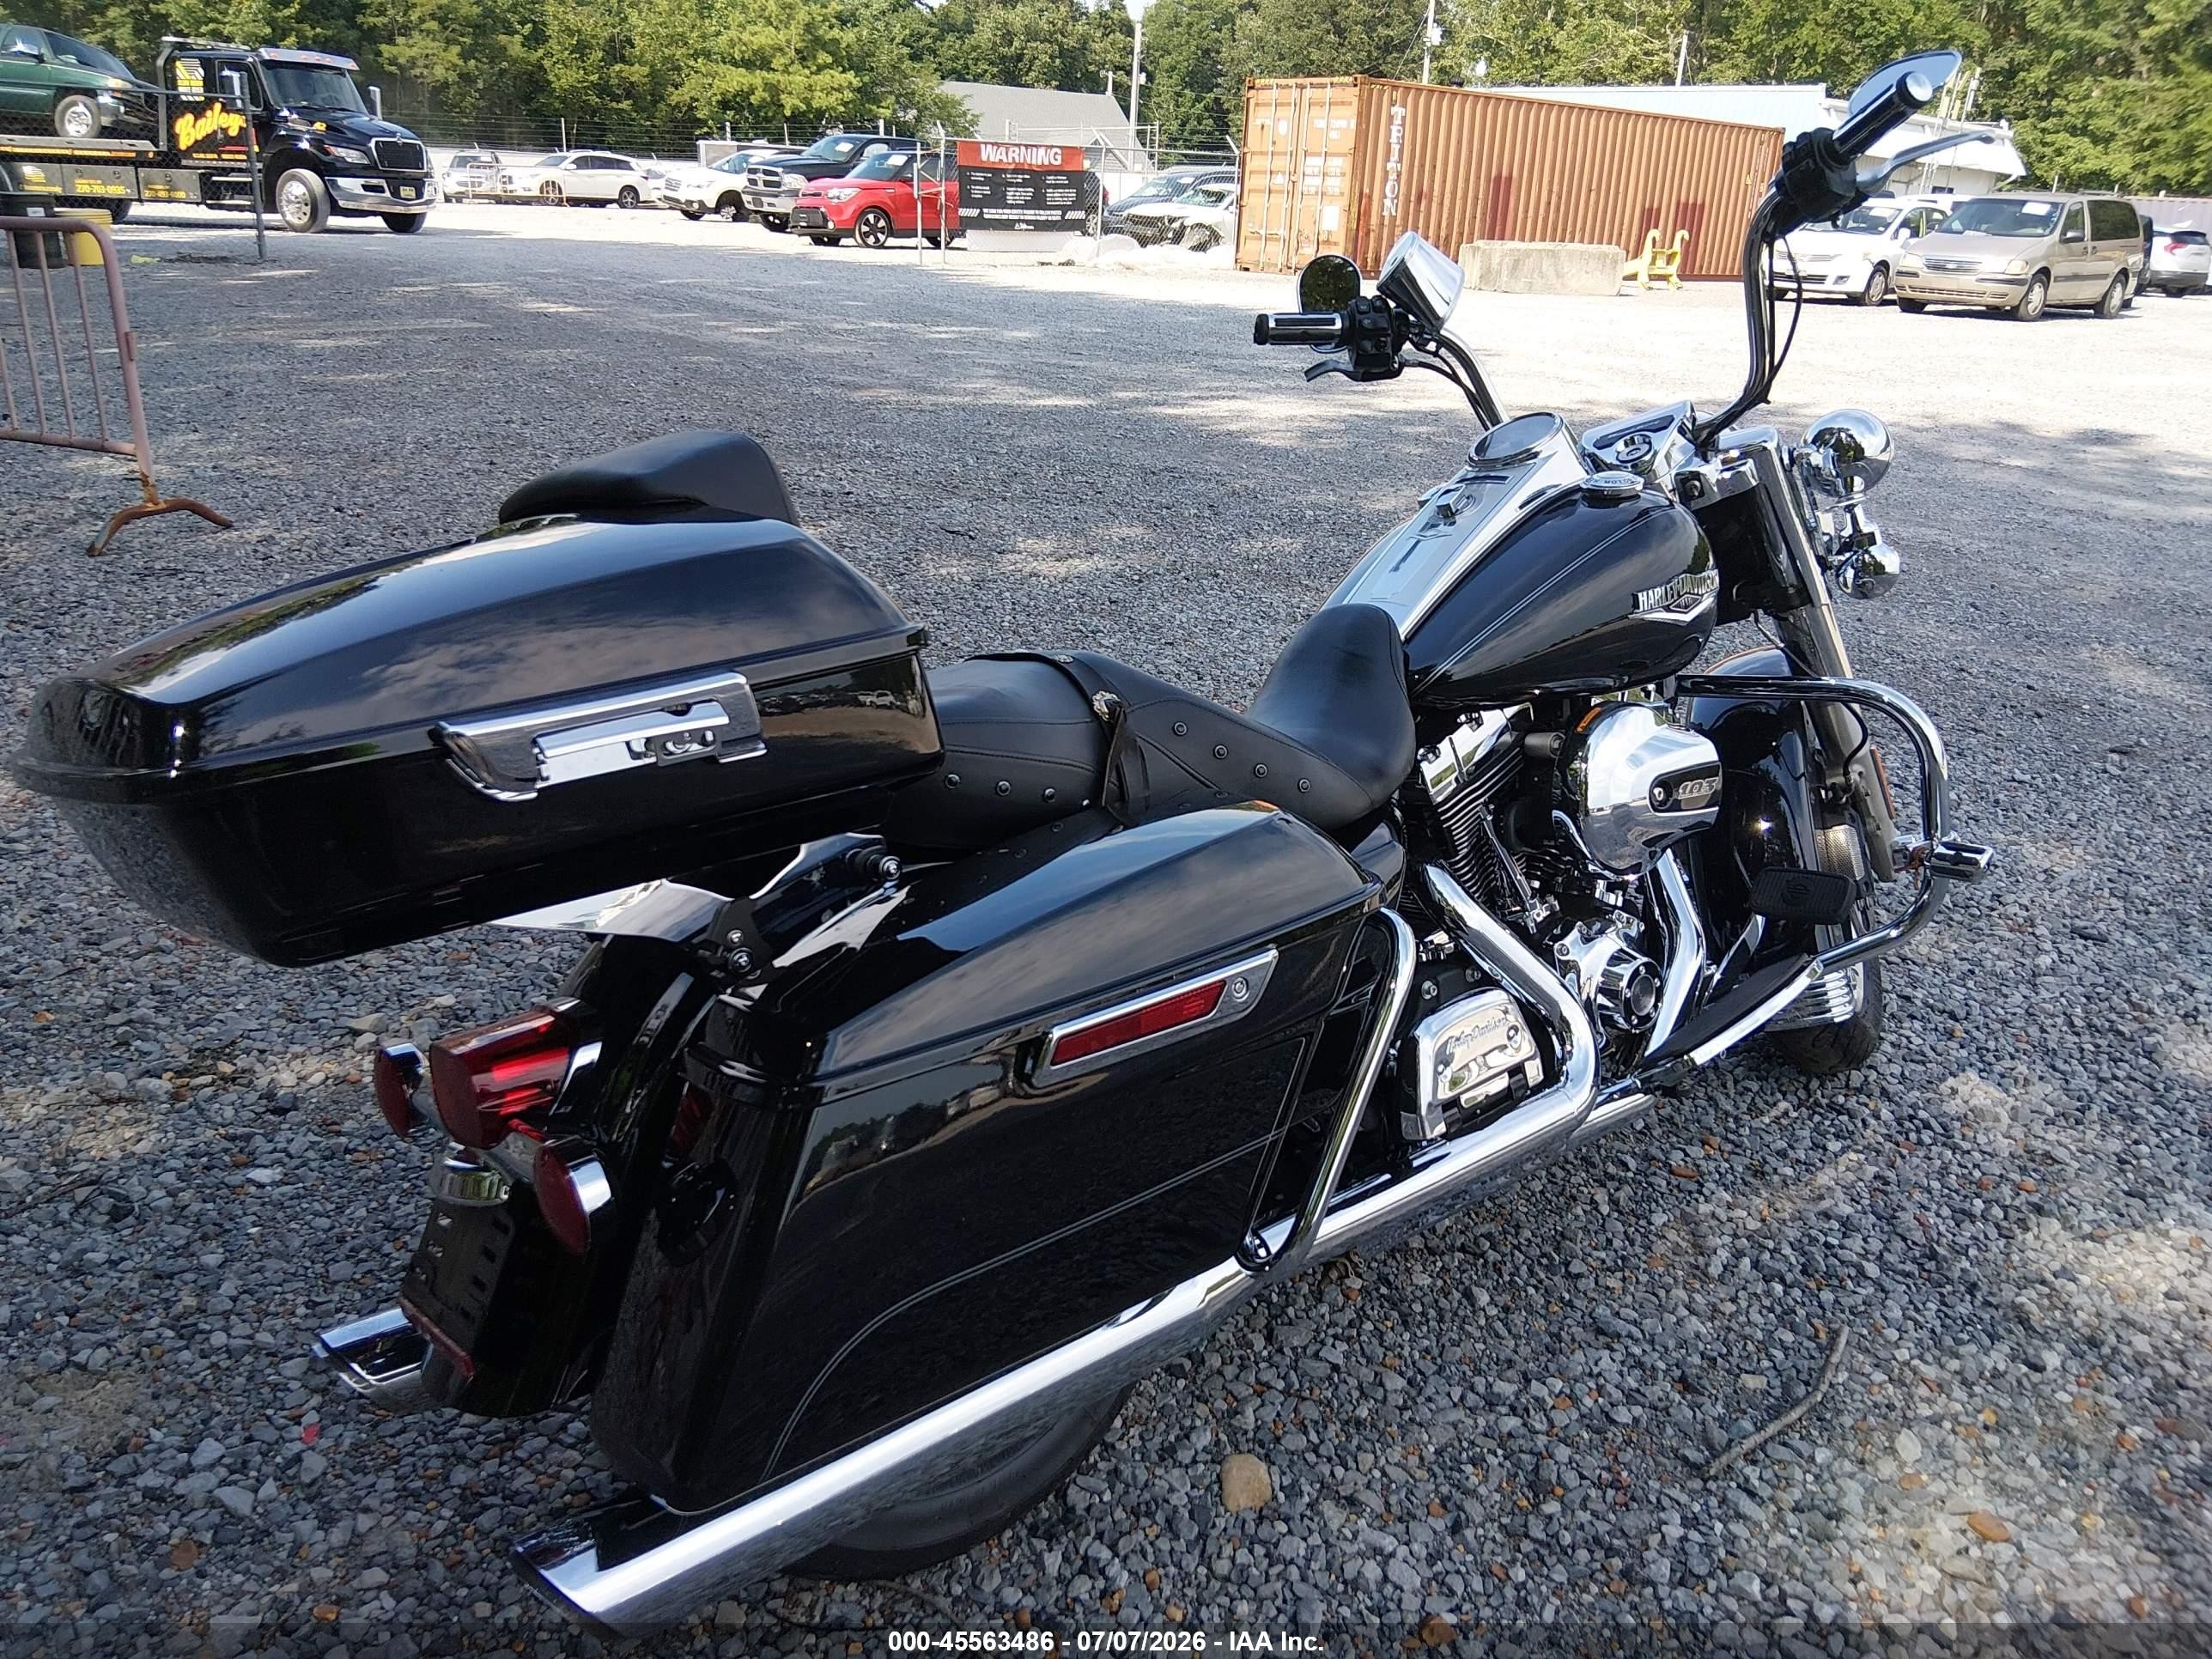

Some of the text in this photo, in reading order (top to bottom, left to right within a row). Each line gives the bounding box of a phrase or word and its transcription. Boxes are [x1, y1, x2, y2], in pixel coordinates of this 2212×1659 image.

[980, 143, 1062, 166] WARNING
[1382, 106, 1406, 216] TRITON
[1678, 777, 1718, 799] 103
